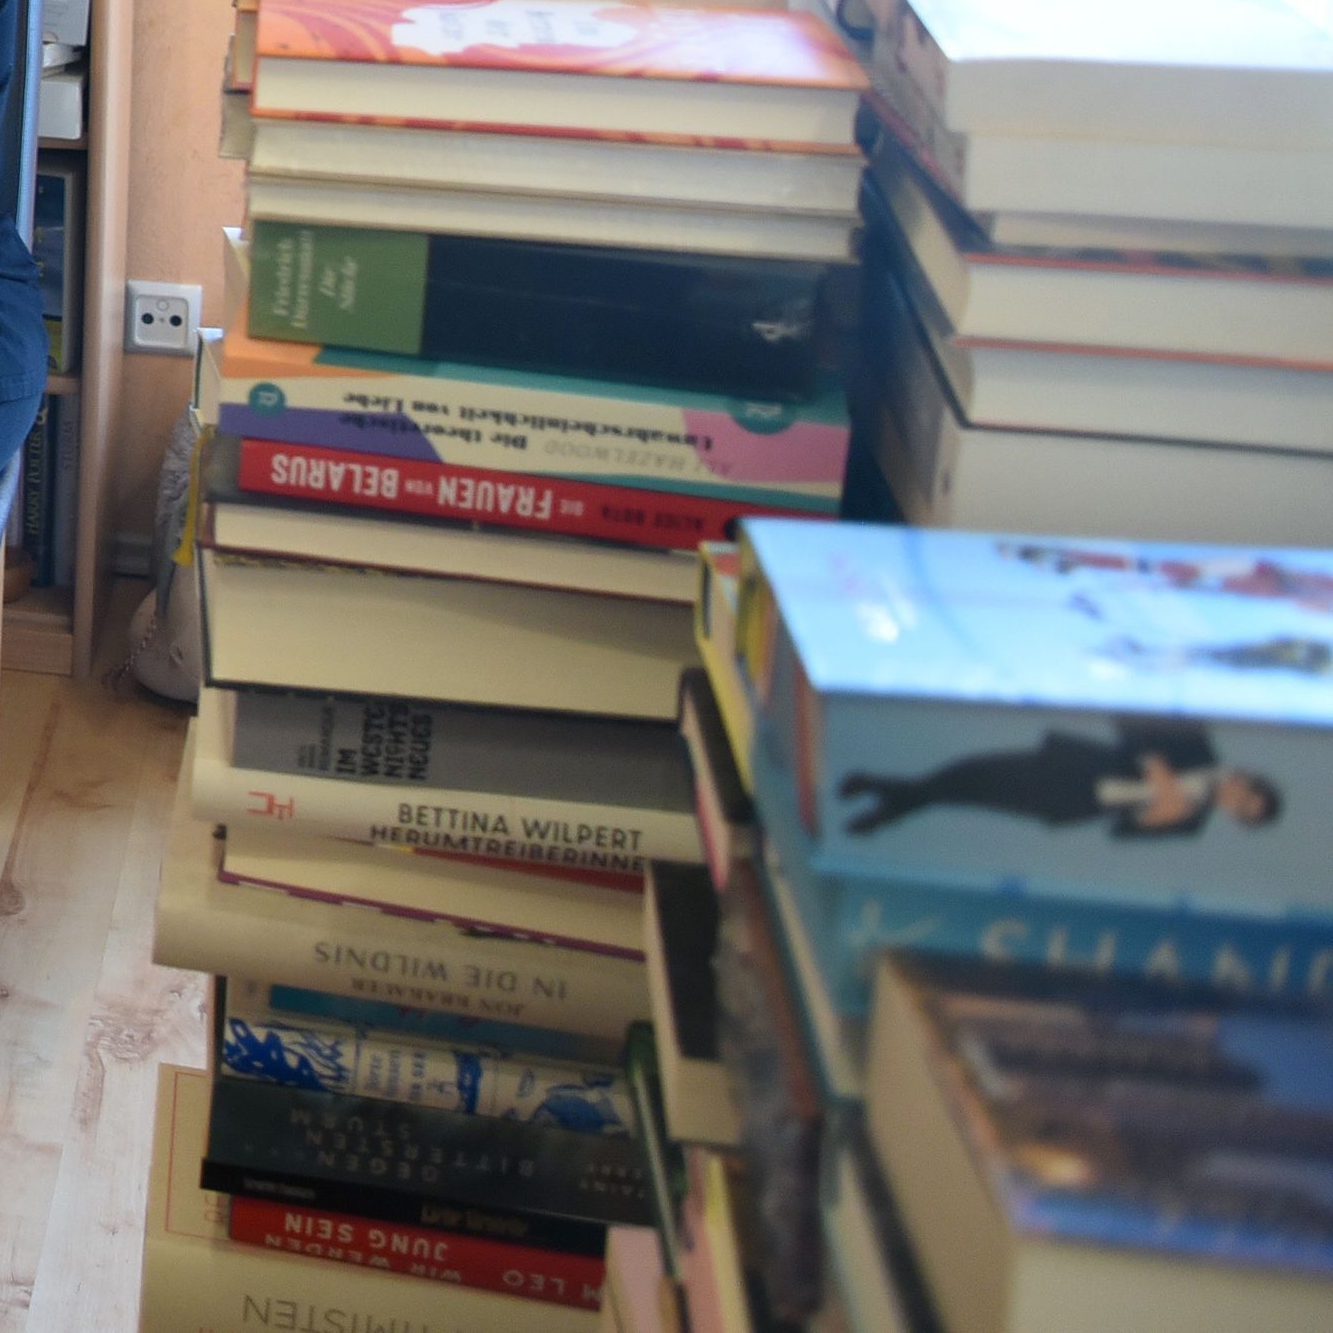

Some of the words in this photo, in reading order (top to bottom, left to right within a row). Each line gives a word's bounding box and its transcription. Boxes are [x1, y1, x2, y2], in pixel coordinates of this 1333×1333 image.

[342, 391, 407, 414] Liebe
[410, 397, 452, 415] von
[338, 410, 484, 448] theoretische
[457, 403, 715, 454] Unwahrscheinlichkeit
[491, 429, 528, 451] Die
[271, 452, 398, 503] BELARUS
[437, 474, 553, 521] FRAUEN
[336, 748, 358, 773] IM
[398, 802, 509, 836] BETTINA
[521, 815, 644, 852] WILPERT
[370, 825, 659, 872] HERUMTREIBERINNE
[313, 940, 450, 981] WILDNIS
[464, 965, 519, 993] DIE
[534, 975, 568, 1001] IN
[284, 1212, 354, 1243] SEIN
[368, 1229, 449, 1262] JUNG
[501, 1268, 567, 1295] LEO
